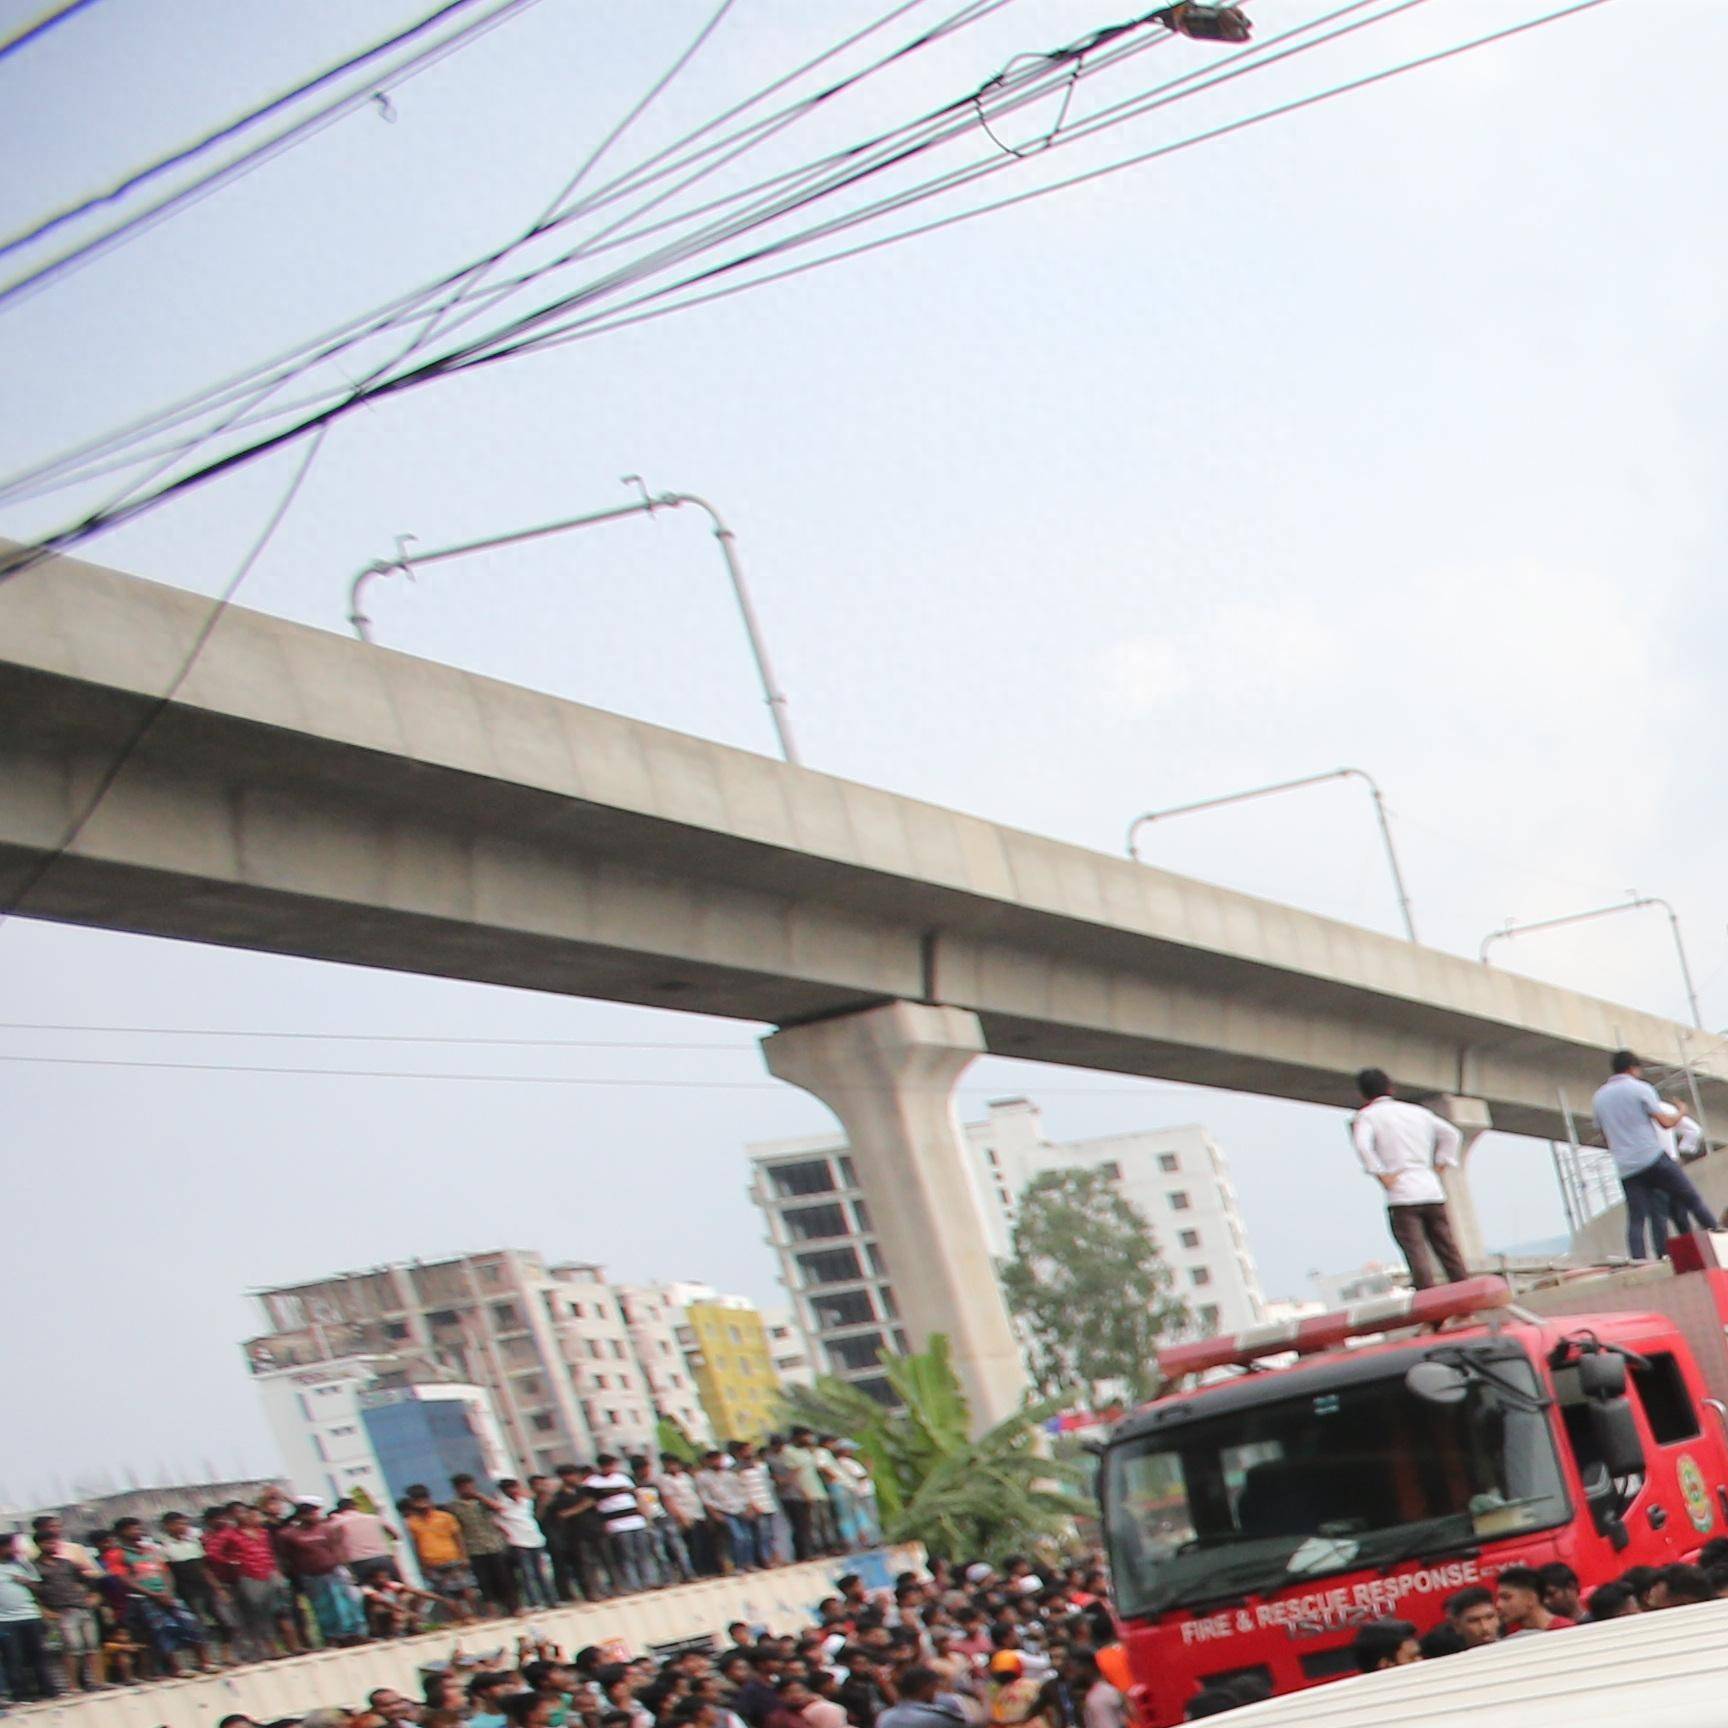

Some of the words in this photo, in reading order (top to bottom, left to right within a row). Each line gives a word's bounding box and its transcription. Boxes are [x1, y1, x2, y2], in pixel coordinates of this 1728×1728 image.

[1180, 1613, 1232, 1646] FIRE
[1236, 1609, 1255, 1633] &
[1256, 1587, 1349, 1629] RESCUE
[1352, 1560, 1480, 1608] RESPONSE
